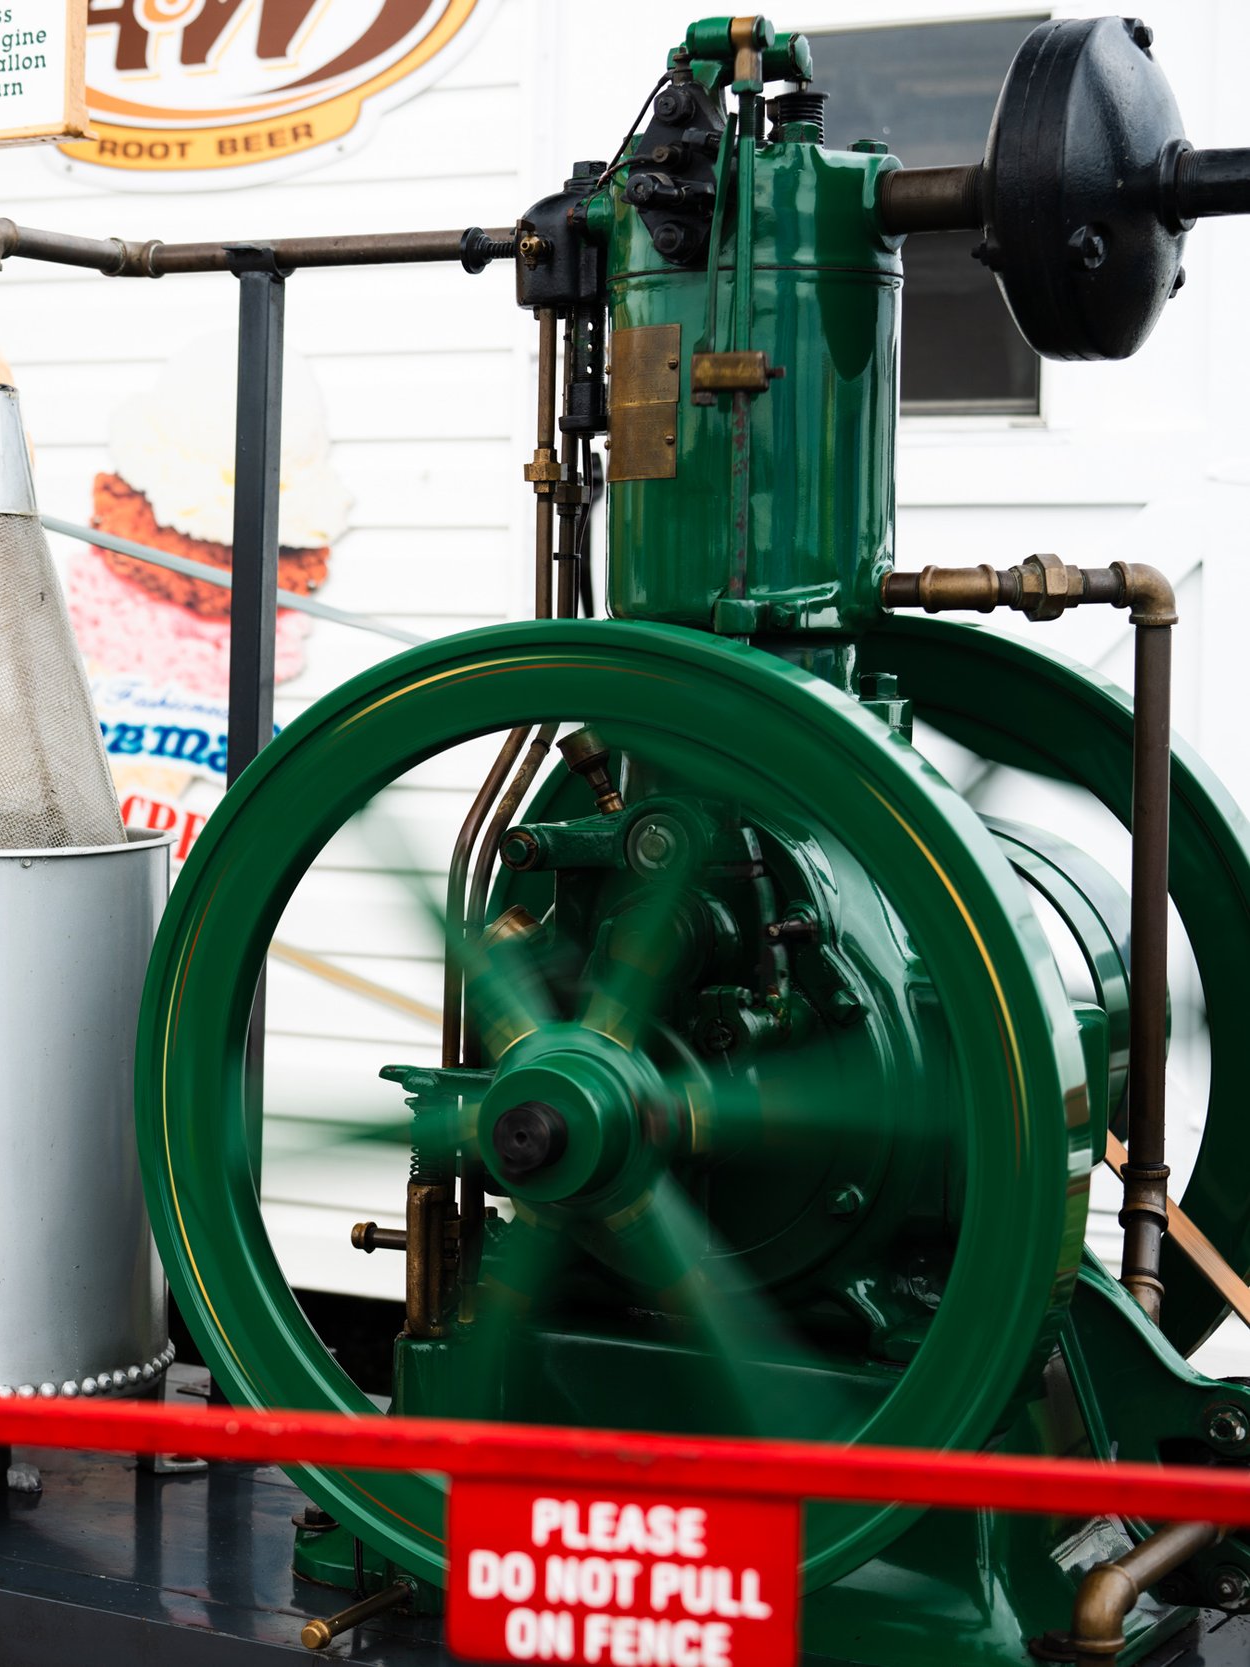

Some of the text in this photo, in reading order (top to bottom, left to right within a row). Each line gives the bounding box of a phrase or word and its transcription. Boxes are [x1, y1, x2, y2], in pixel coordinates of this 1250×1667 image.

[98, 123, 313, 160] ROOT BEER
[532, 1497, 707, 1558] PLEASE
[468, 1549, 773, 1620] DO NOT PULL
[505, 1607, 733, 1667] ON FENCE
